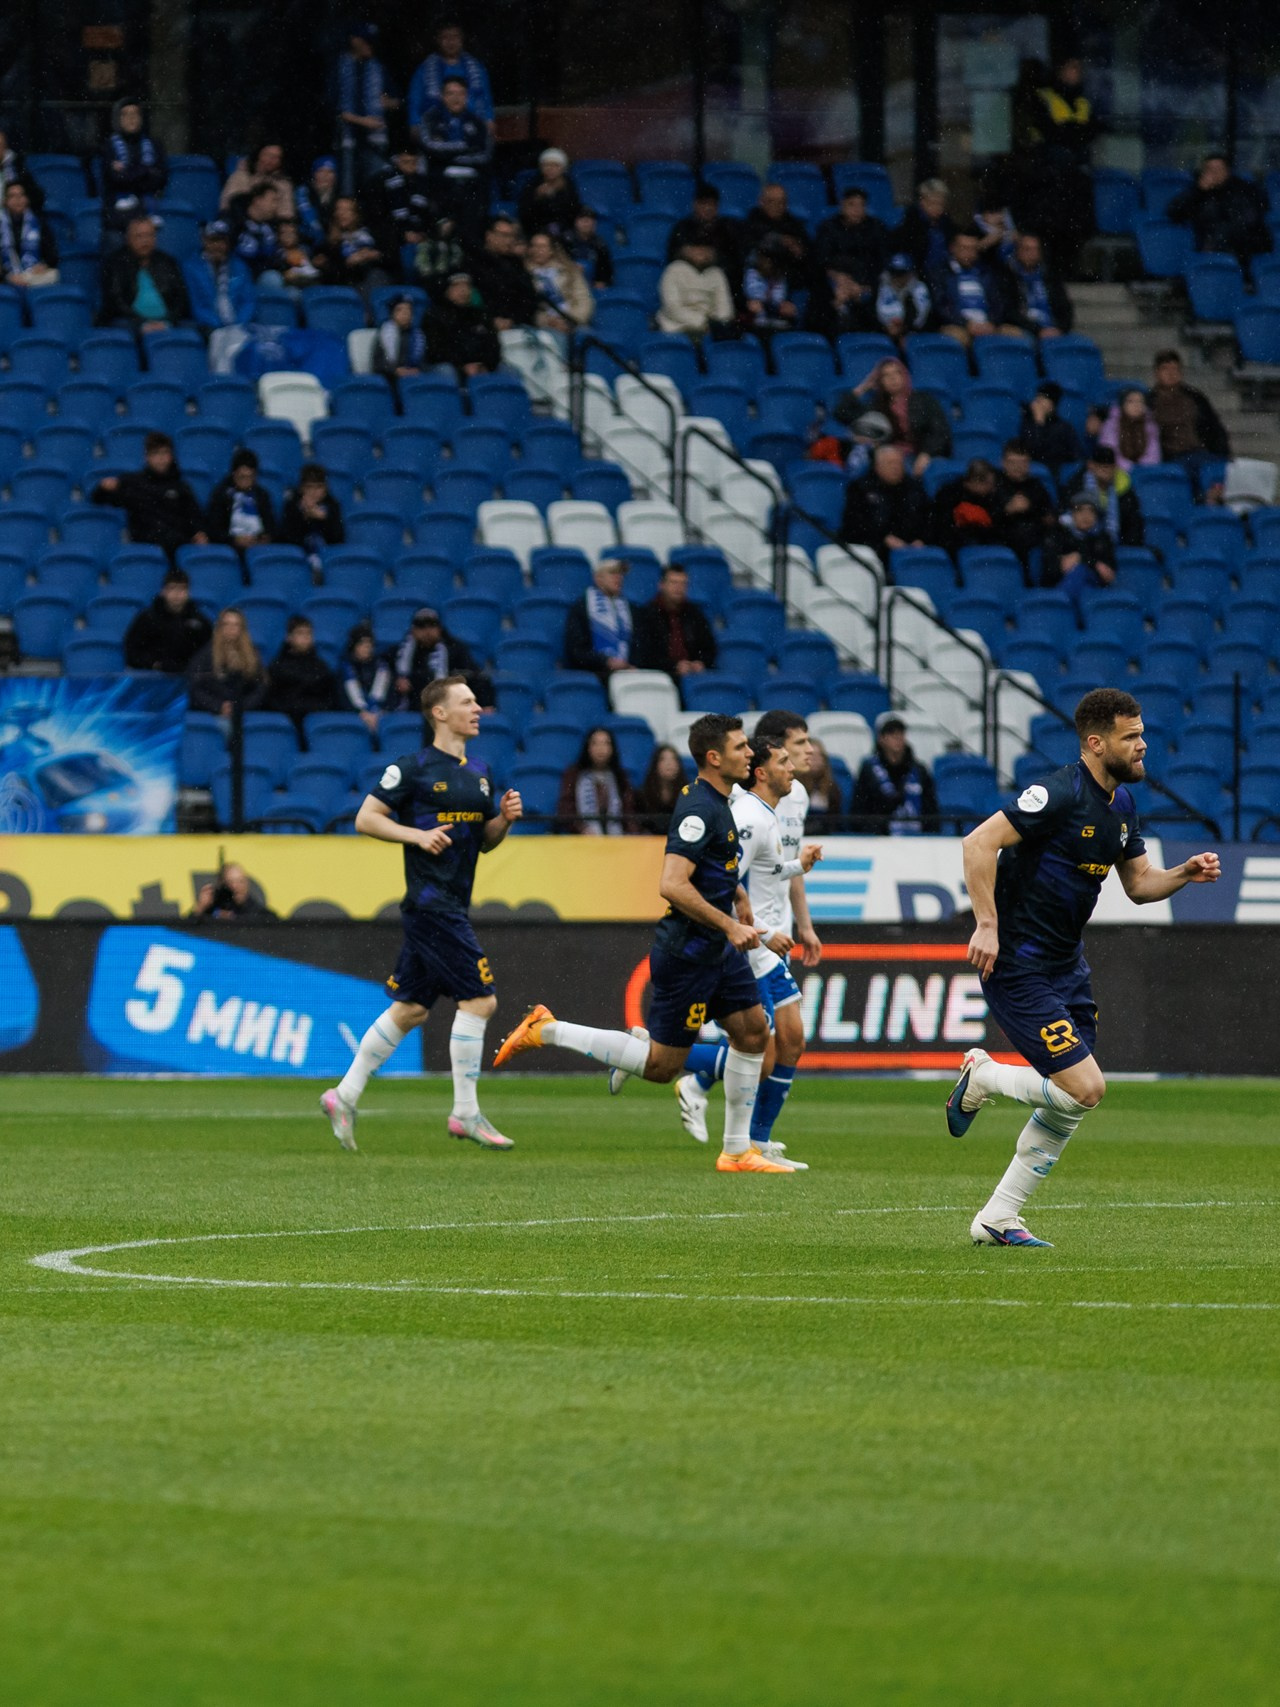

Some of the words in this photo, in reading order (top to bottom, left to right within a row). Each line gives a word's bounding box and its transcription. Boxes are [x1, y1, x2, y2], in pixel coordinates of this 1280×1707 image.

[126, 943, 195, 1033] 5
[187, 991, 313, 1067] МИН
[699, 973, 989, 1043] LINE
